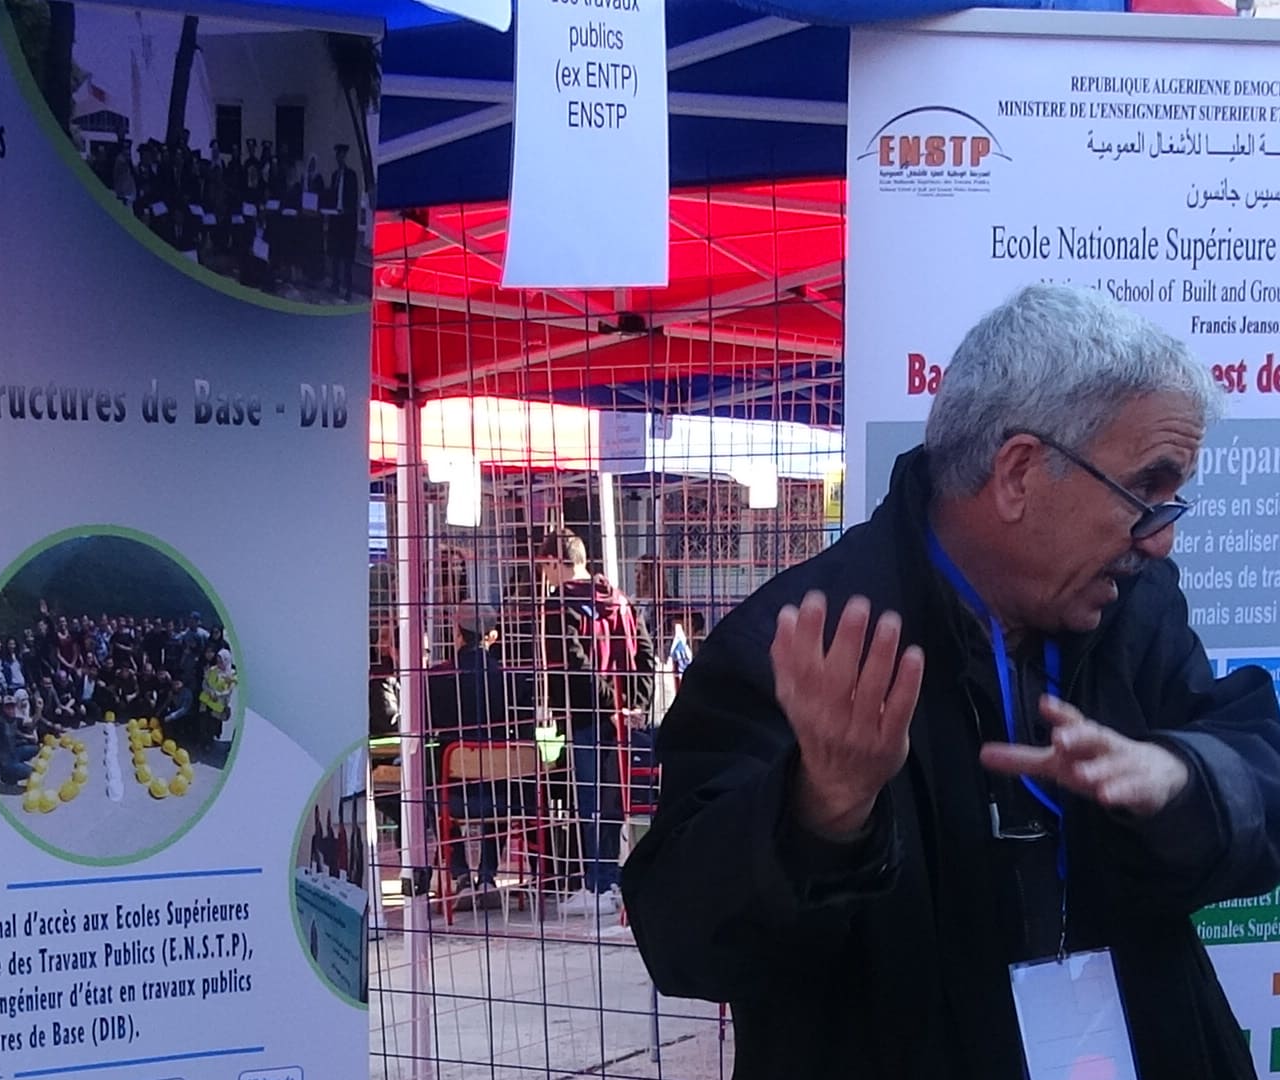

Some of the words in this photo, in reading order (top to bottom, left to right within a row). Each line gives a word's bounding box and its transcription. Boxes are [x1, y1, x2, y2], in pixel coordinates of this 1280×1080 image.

[569, 22, 624, 52] publics
[555, 59, 581, 92] (ex
[587, 61, 638, 97] ENTP)
[1071, 76, 1150, 97] REPUBLIQUE
[1152, 78, 1231, 97] ALGERIENNE
[568, 101, 627, 129] ENSTP
[998, 100, 1066, 118] MINISTERE
[1070, 102, 1087, 118] DE
[1090, 102, 1196, 121] L'ENSEIGNEMENT
[1199, 104, 1267, 123] SUPERIEUR
[879, 136, 990, 168] ENSTP
[991, 225, 1050, 260] Ecole
[1057, 226, 1159, 262] Nationale
[1166, 226, 1276, 270] Supérieure
[1106, 279, 1154, 303] School
[1158, 279, 1176, 303] of
[1182, 279, 1216, 303] Built
[1221, 279, 1246, 303] and
[1191, 315, 1236, 335] Francis
[141, 379, 177, 424] de
[194, 379, 262, 426] Base
[299, 383, 348, 429] DIB
[1232, 498, 1251, 516] en
[24, 909, 77, 937] d'accès
[83, 912, 109, 932] aux
[116, 903, 160, 929] Ecoles
[166, 897, 249, 928] Supérieures
[8, 951, 32, 976] des
[39, 947, 97, 974] Travaux
[104, 941, 155, 968] Publics
[161, 932, 253, 966] (E.N.S.T.P),
[69, 981, 113, 1008] d'état
[119, 985, 135, 1003] en
[142, 977, 196, 1001] travaux
[202, 968, 252, 1000] publics
[29, 1024, 47, 1049] de
[52, 1021, 85, 1047] Base
[92, 1014, 140, 1047] (DIB).
